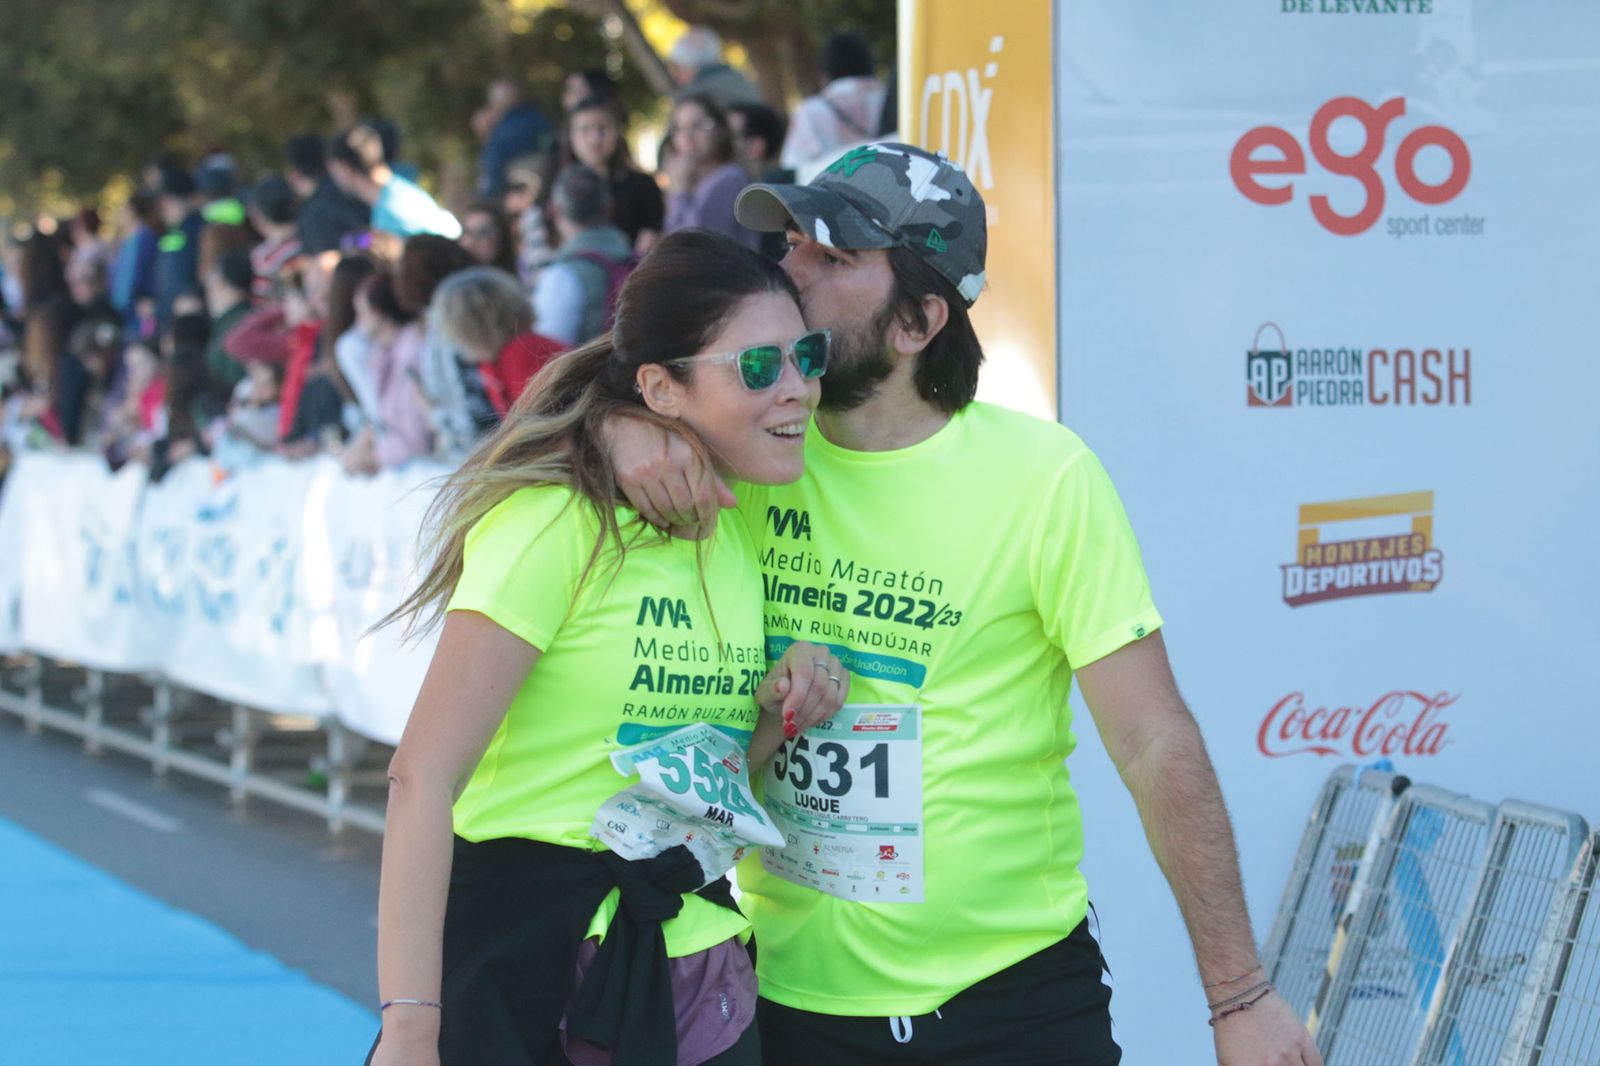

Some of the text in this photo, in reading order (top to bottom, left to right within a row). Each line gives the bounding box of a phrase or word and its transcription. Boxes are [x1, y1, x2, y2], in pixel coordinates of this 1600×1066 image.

[1281, 0, 1433, 14] DE LEVANTE
[1230, 97, 1471, 237] ego
[1387, 213, 1486, 238] sport center
[1297, 346, 1363, 376] AARÓN
[1368, 349, 1472, 405] CASH
[1297, 379, 1364, 406] PIEDRA
[1306, 535, 1425, 566] MONTAJES
[830, 558, 943, 597] Maratón
[1285, 551, 1442, 598] DEPORTIVOS
[633, 637, 709, 663] Medio
[810, 621, 844, 639] RUIZ
[846, 627, 932, 657] ANDÚJAR
[629, 664, 735, 696] Almería
[622, 702, 689, 720] RAMÓN
[692, 706, 726, 721] RUIZ
[794, 791, 841, 814] LUQUE
